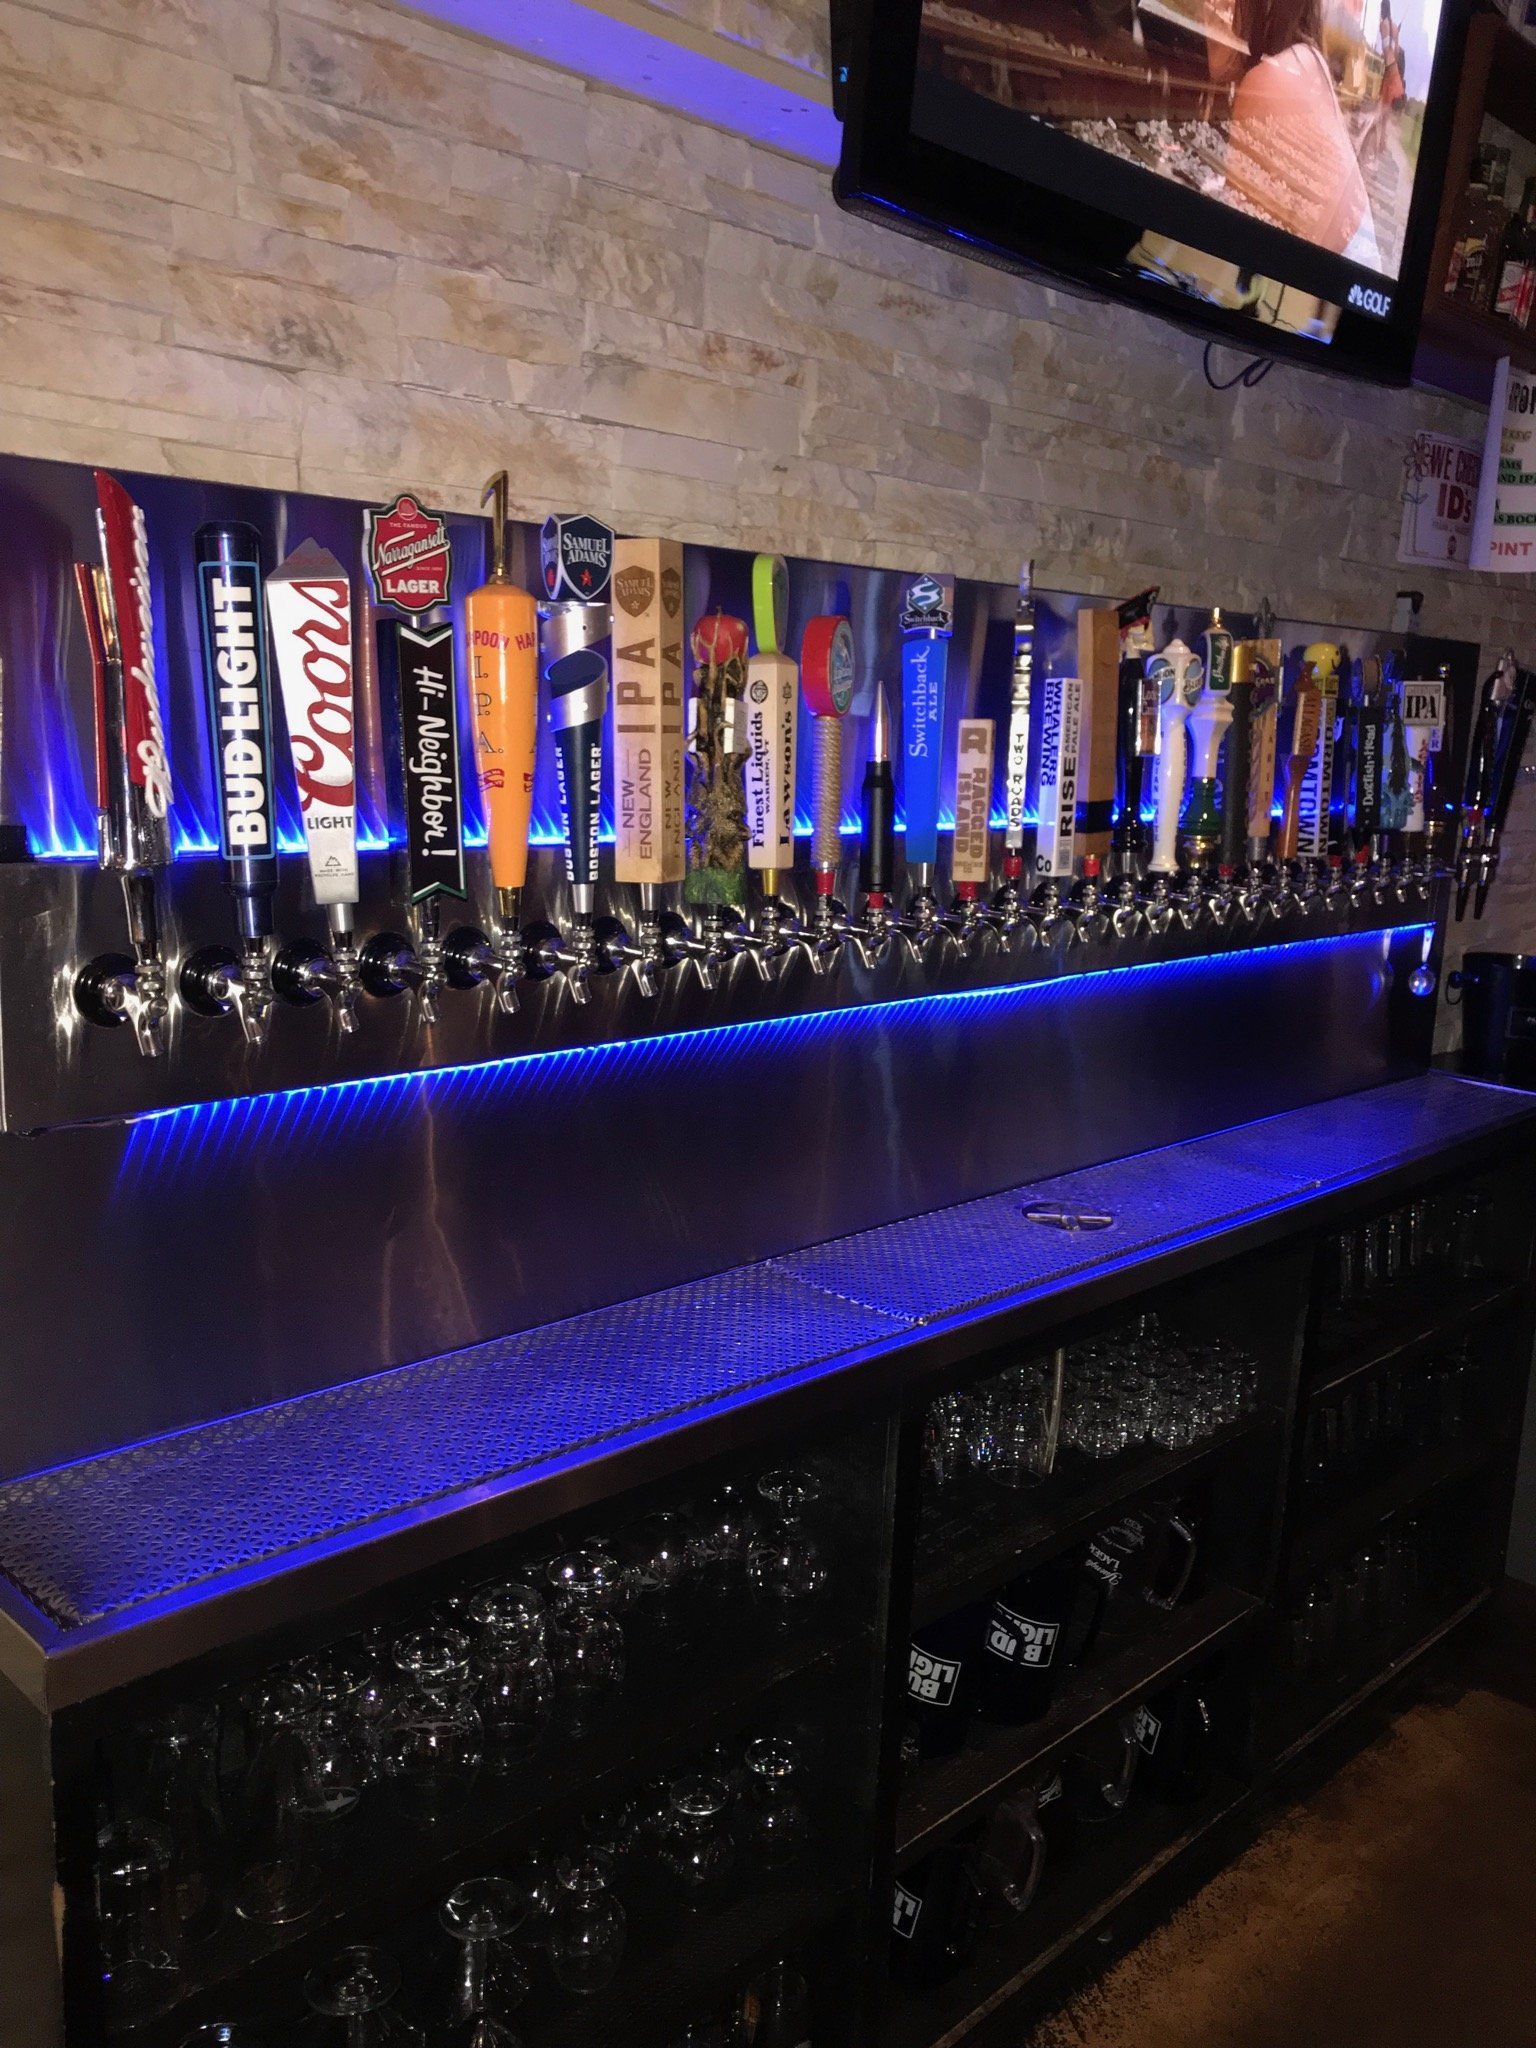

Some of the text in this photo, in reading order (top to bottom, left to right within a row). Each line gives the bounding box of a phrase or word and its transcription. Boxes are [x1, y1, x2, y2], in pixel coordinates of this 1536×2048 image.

[1363, 288, 1391, 317] GOLF
[373, 526, 450, 570] Narragansett
[563, 532, 610, 555] SAMUEL
[567, 550, 607, 568] ADAMS
[386, 579, 440, 594] LAGER
[616, 576, 654, 589] SAMUEL
[620, 586, 650, 598] ADAMS
[212, 577, 268, 846] BUD LIGHT
[289, 580, 354, 811] Coors
[616, 638, 656, 733] IPA
[910, 645, 931, 758] Switchback
[928, 681, 938, 722] ALE
[1064, 683, 1073, 752] AMERICAN
[1405, 695, 1437, 719] IPA
[1041, 682, 1054, 787] BREWING
[1049, 681, 1063, 786] WHALERS
[622, 779, 635, 828] NEW
[639, 748, 652, 859] ENGLAND
[751, 711, 766, 848] Finest Liquids
[779, 711, 792, 846] Lawson's
[955, 773, 972, 853] ISLAND
[970, 768, 987, 858] RAGGED
[1009, 733, 1025, 828] TWO ROADS
[1060, 757, 1077, 837] RISE
[307, 816, 352, 829] LIGHT
[588, 812, 600, 881] BOSTON
[1036, 854, 1051, 873] Co
